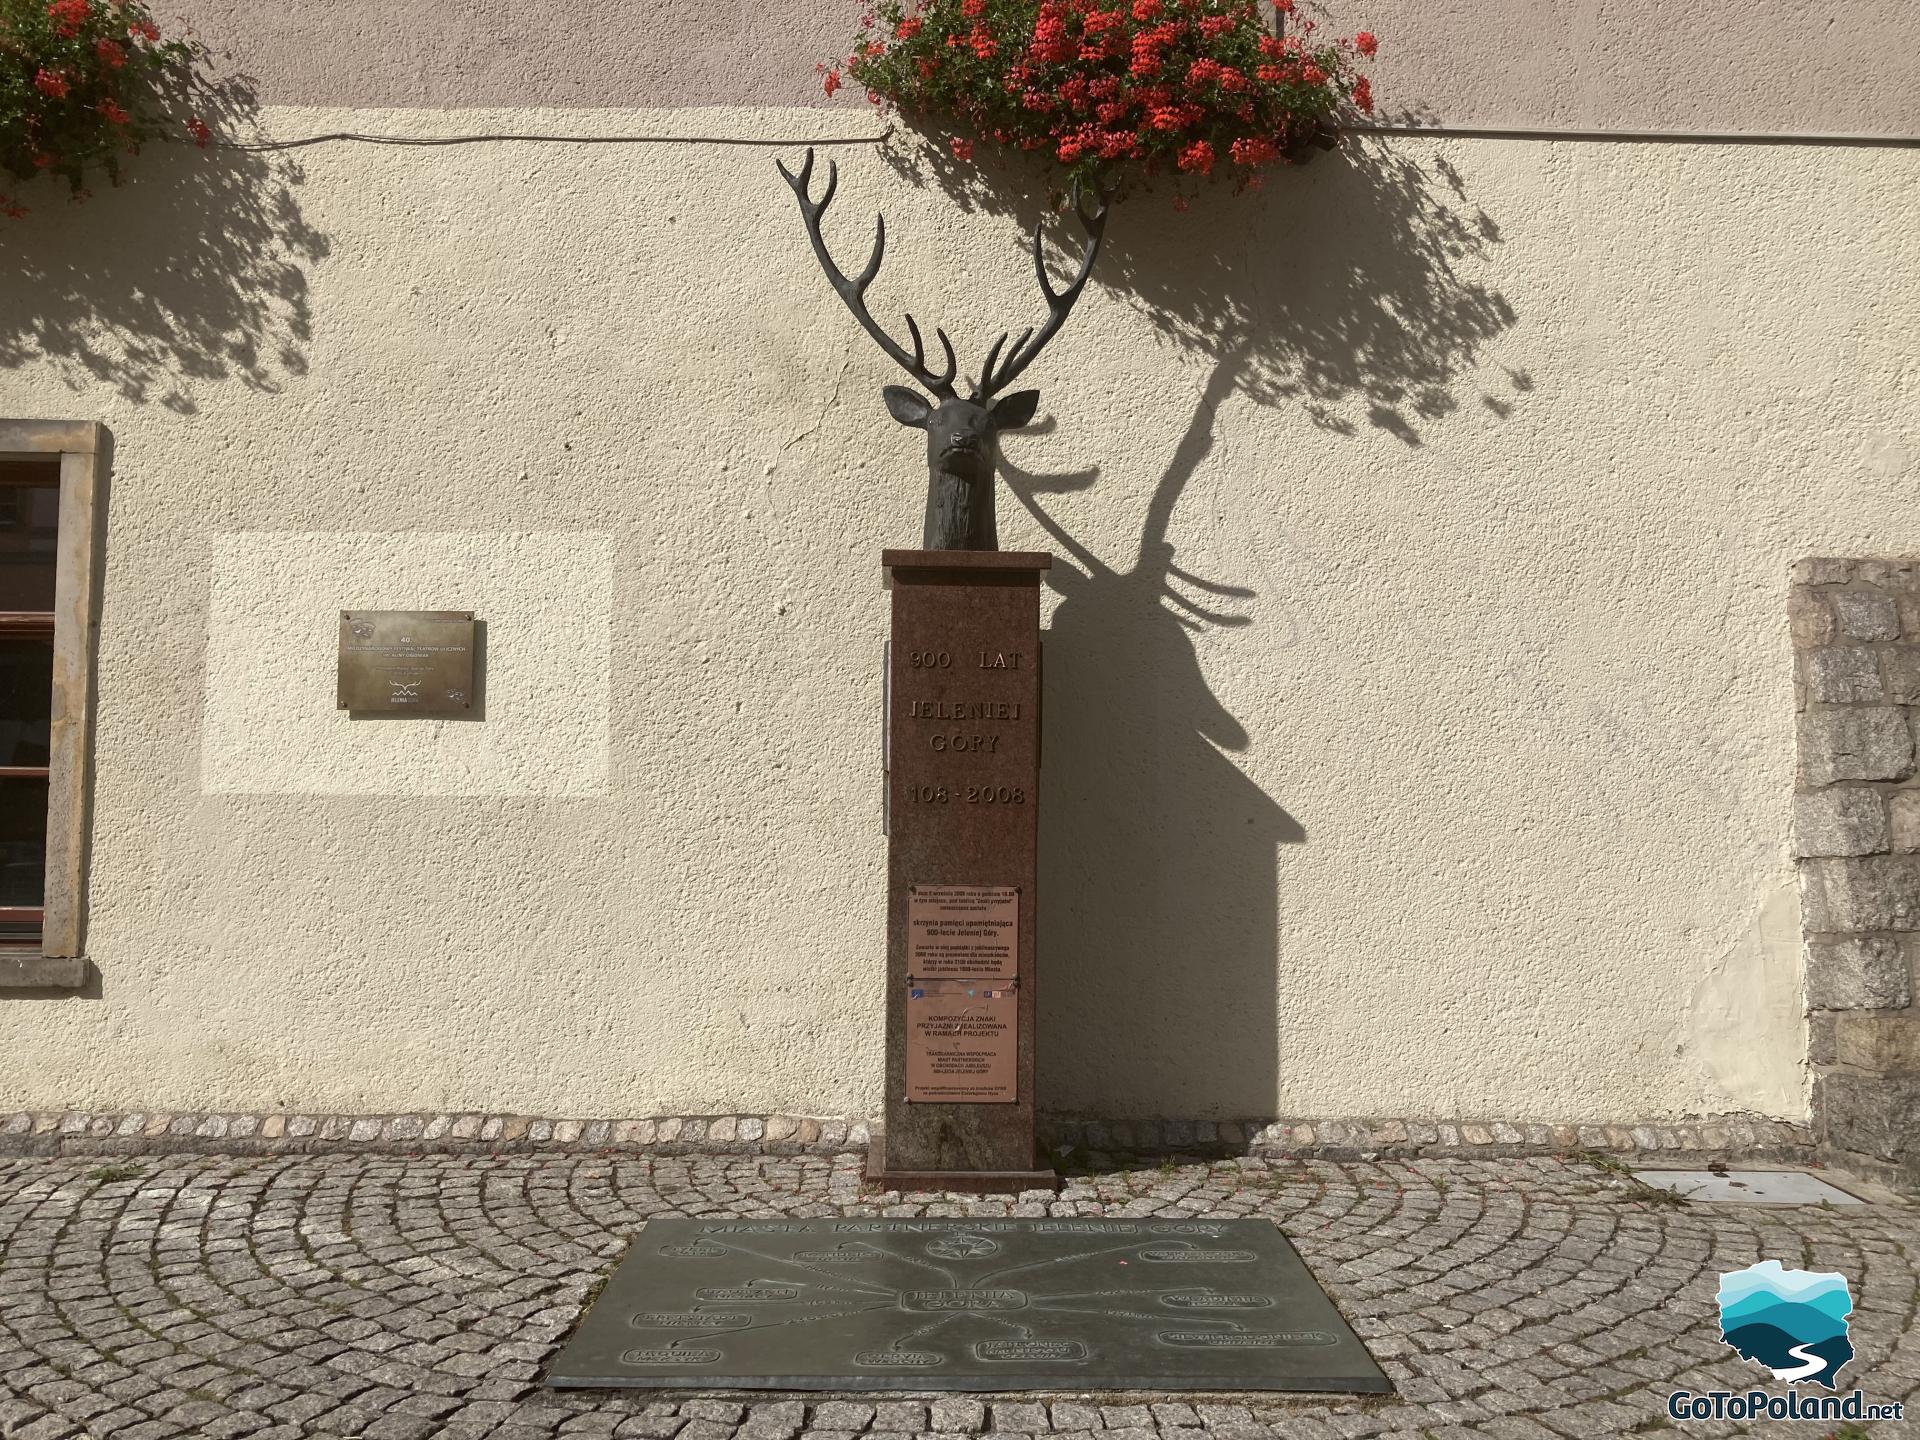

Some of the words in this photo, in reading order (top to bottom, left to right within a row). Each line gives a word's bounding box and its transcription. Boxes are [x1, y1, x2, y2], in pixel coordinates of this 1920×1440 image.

[911, 651, 952, 668] 900
[979, 652, 1023, 669] LAT
[909, 701, 1021, 720] JELENIEJ
[913, 920, 938, 928] skrzynia
[940, 920, 964, 928] pamięci
[966, 920, 1013, 929] upamiętniająca
[957, 929, 982, 937] Jeleniej
[700, 1223, 817, 1233] MIASTA
[832, 1223, 1017, 1233] PARTNERSKIE
[1032, 1223, 1138, 1233] JELENIEJ
[914, 1291, 1014, 1299] JELENIA
